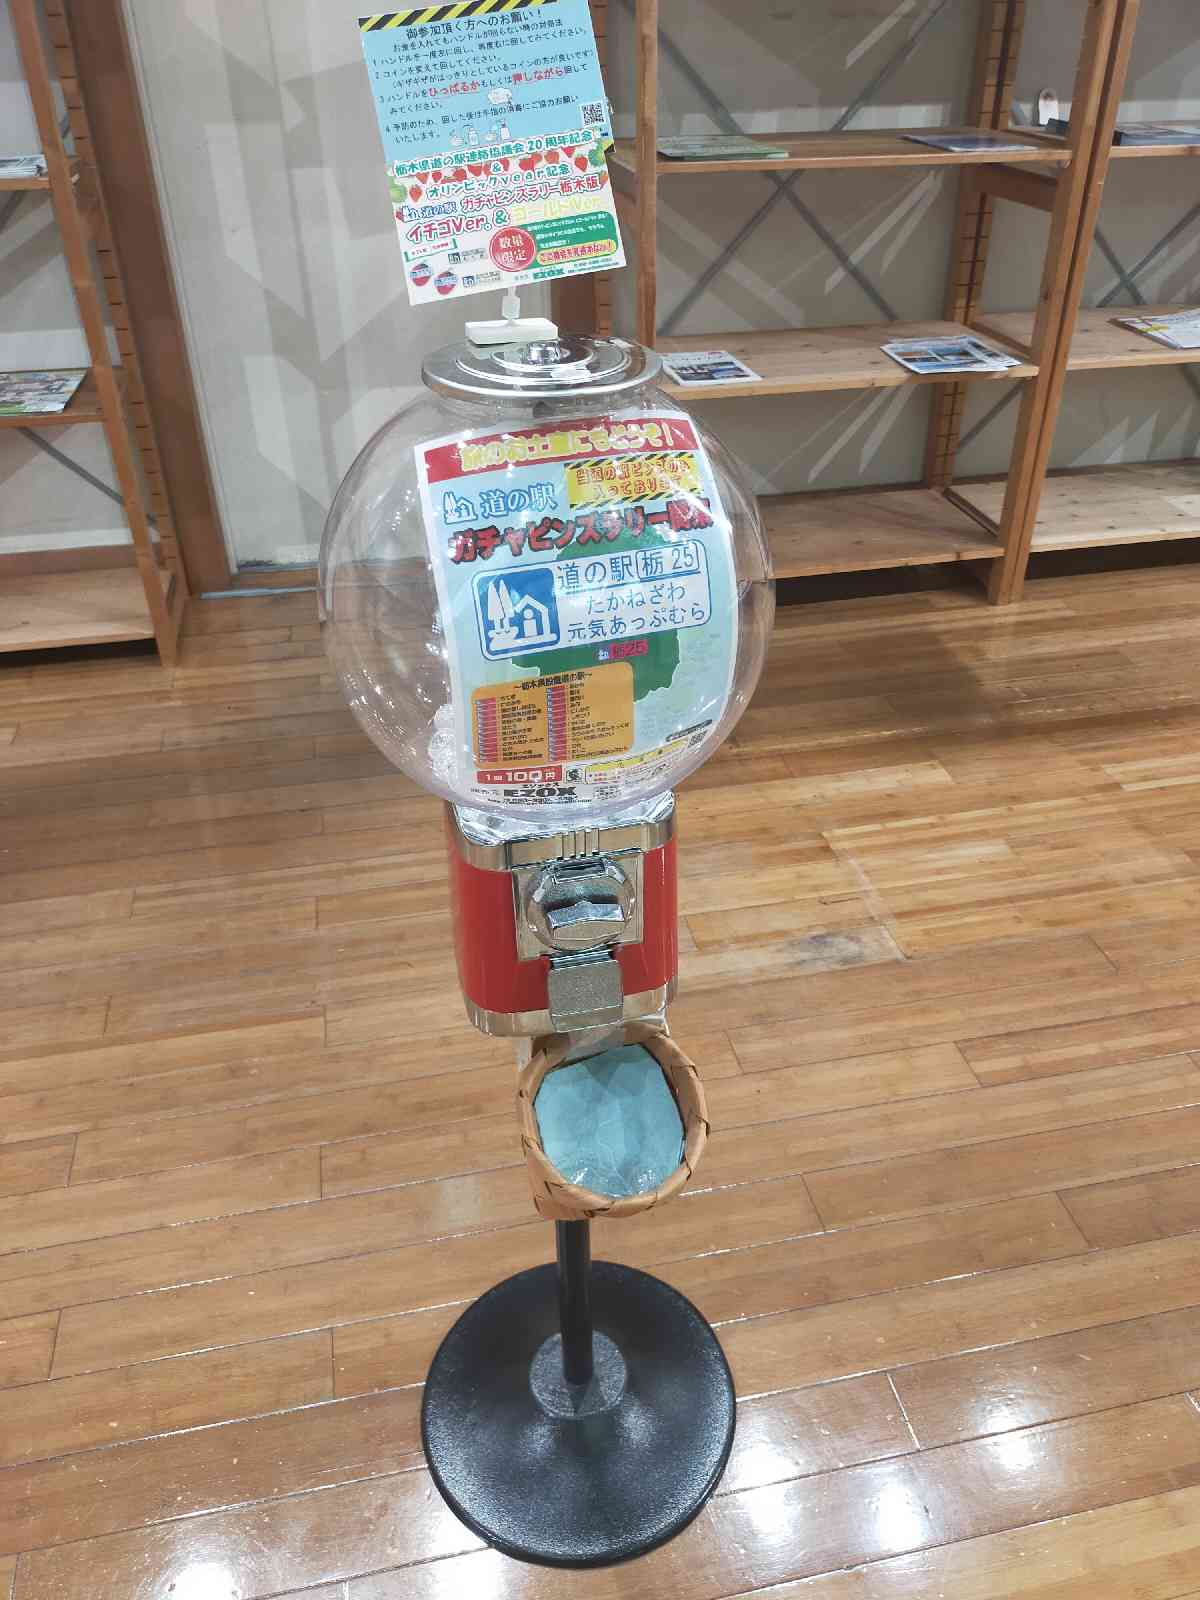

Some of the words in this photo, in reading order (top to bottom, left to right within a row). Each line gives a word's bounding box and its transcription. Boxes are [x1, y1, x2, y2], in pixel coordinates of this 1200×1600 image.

[480, 482, 558, 519] 道の駅
[557, 555, 634, 590] 道の駅
[587, 582, 686, 616] たかねざわ
[568, 603, 705, 641] 元気あっぷむら
[503, 786, 577, 799] EZOX
